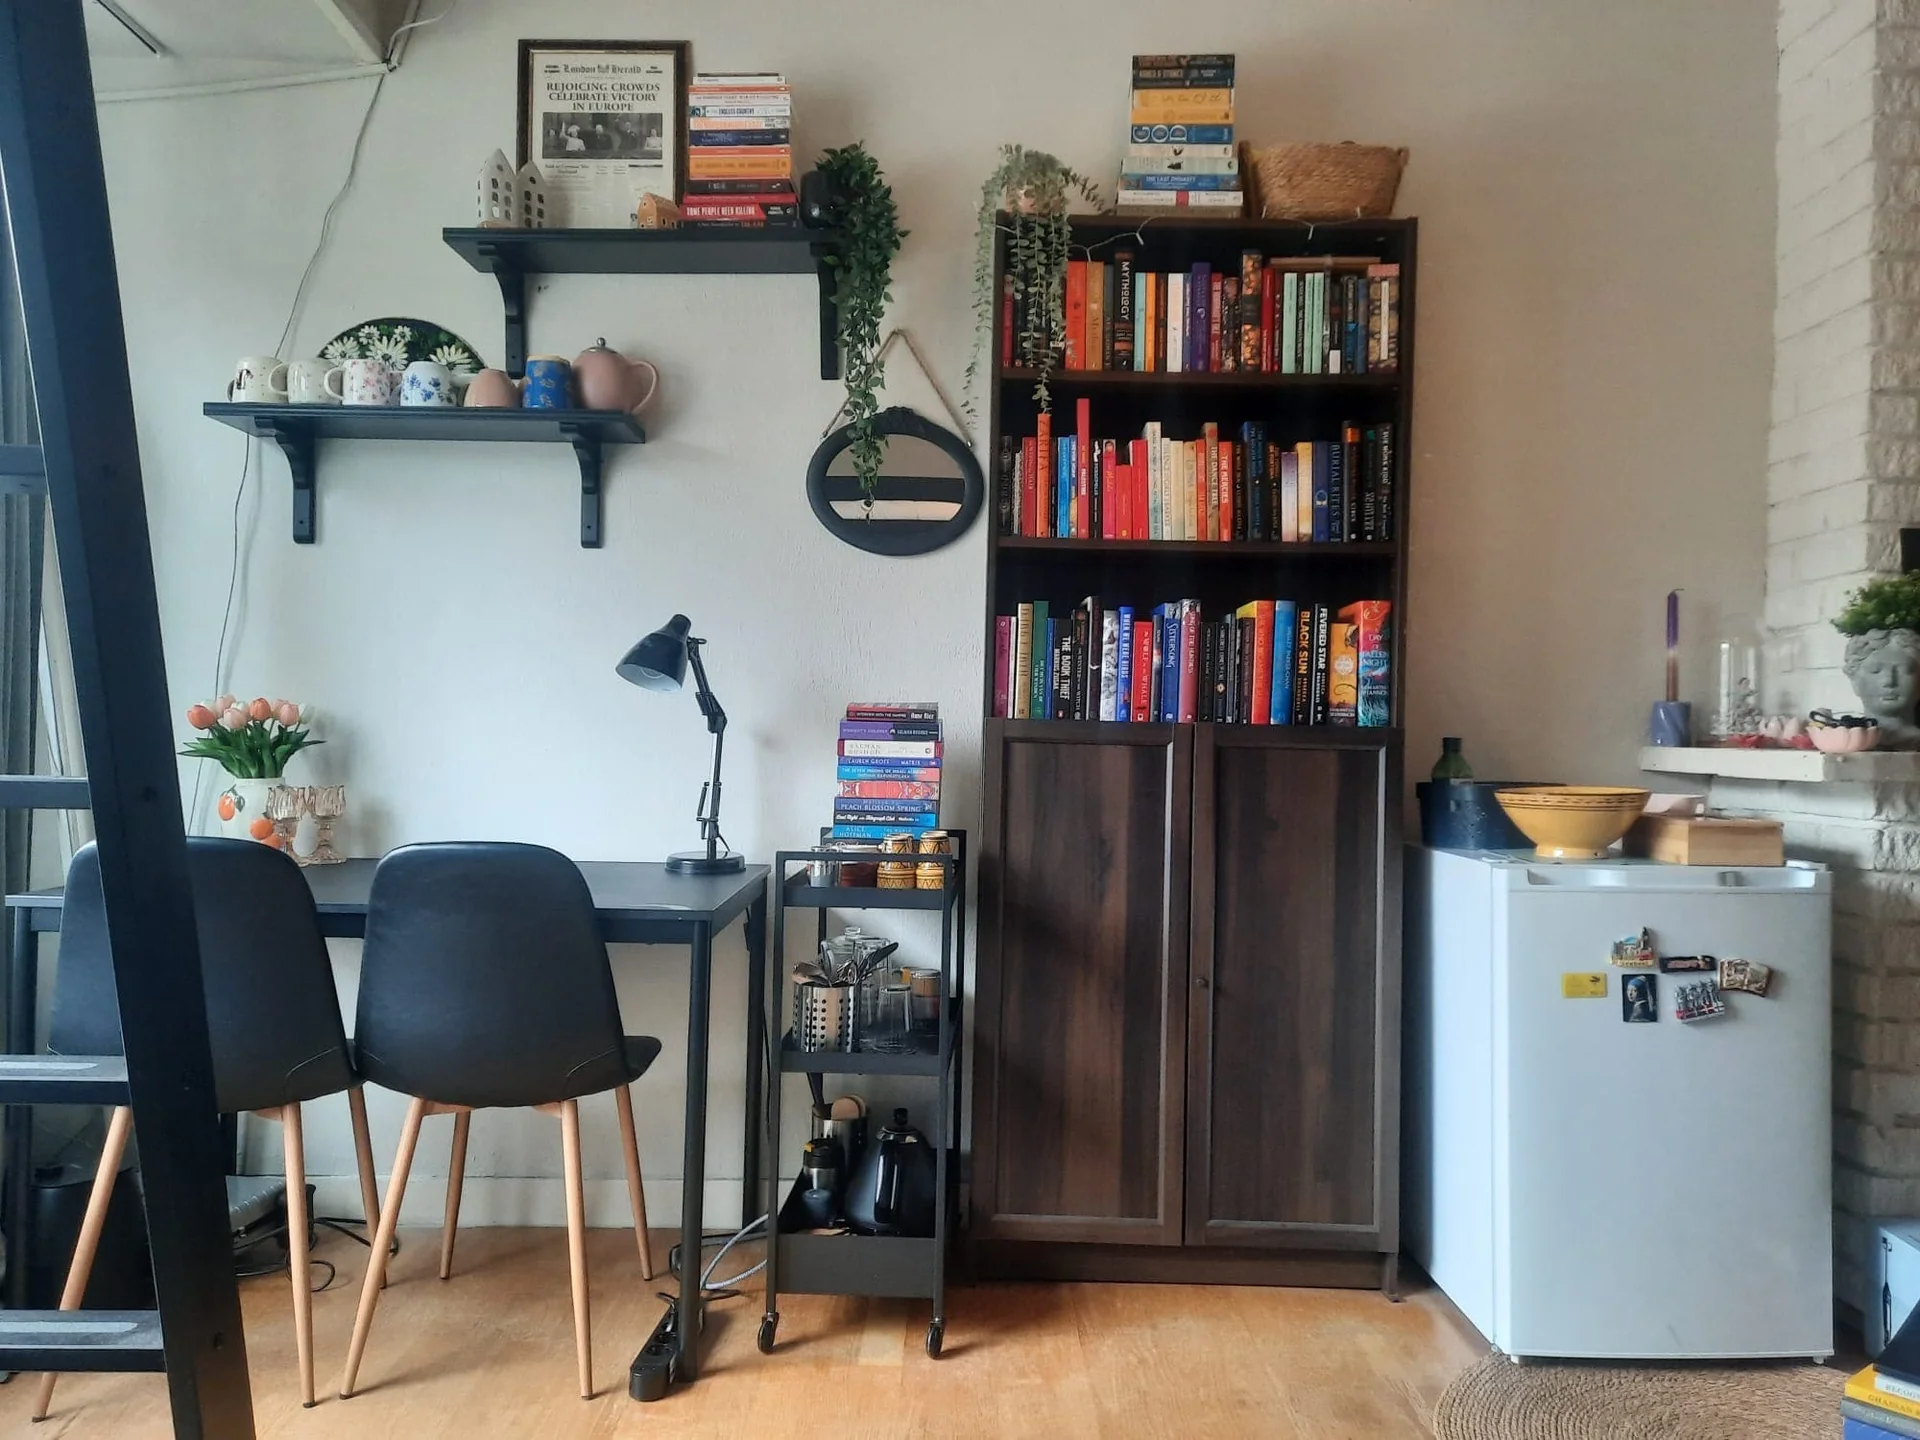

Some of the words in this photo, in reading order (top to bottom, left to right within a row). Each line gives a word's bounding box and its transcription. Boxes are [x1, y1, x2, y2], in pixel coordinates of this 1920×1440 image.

[563, 64, 596, 74] London
[611, 64, 641, 74] Herald
[546, 82, 607, 92] REJOICING
[611, 82, 660, 92] CROWDS
[548, 92, 607, 101] CELEBRATE
[611, 92, 658, 101] VICTORY
[572, 102, 585, 111] IN
[588, 102, 634, 111] EUROPE
[1132, 124, 1187, 143] GOD
[1120, 260, 1131, 320] MYTHOLOGY
[1220, 455, 1229, 470] THE
[1220, 470, 1229, 504] MERCIES
[1331, 486, 1341, 517] RITES
[1299, 610, 1311, 648] BLACK
[1318, 608, 1328, 647] FEVERED
[1061, 635, 1072, 652] THE
[1165, 622, 1179, 669] SISTERSONG
[1060, 654, 1071, 677] BOOK
[1298, 650, 1309, 674] SUN
[1317, 647, 1327, 670] STAR
[1059, 678, 1070, 700] THIEF
[864, 804, 895, 812] BLOSSOM
[896, 805, 921, 813] SPRING
